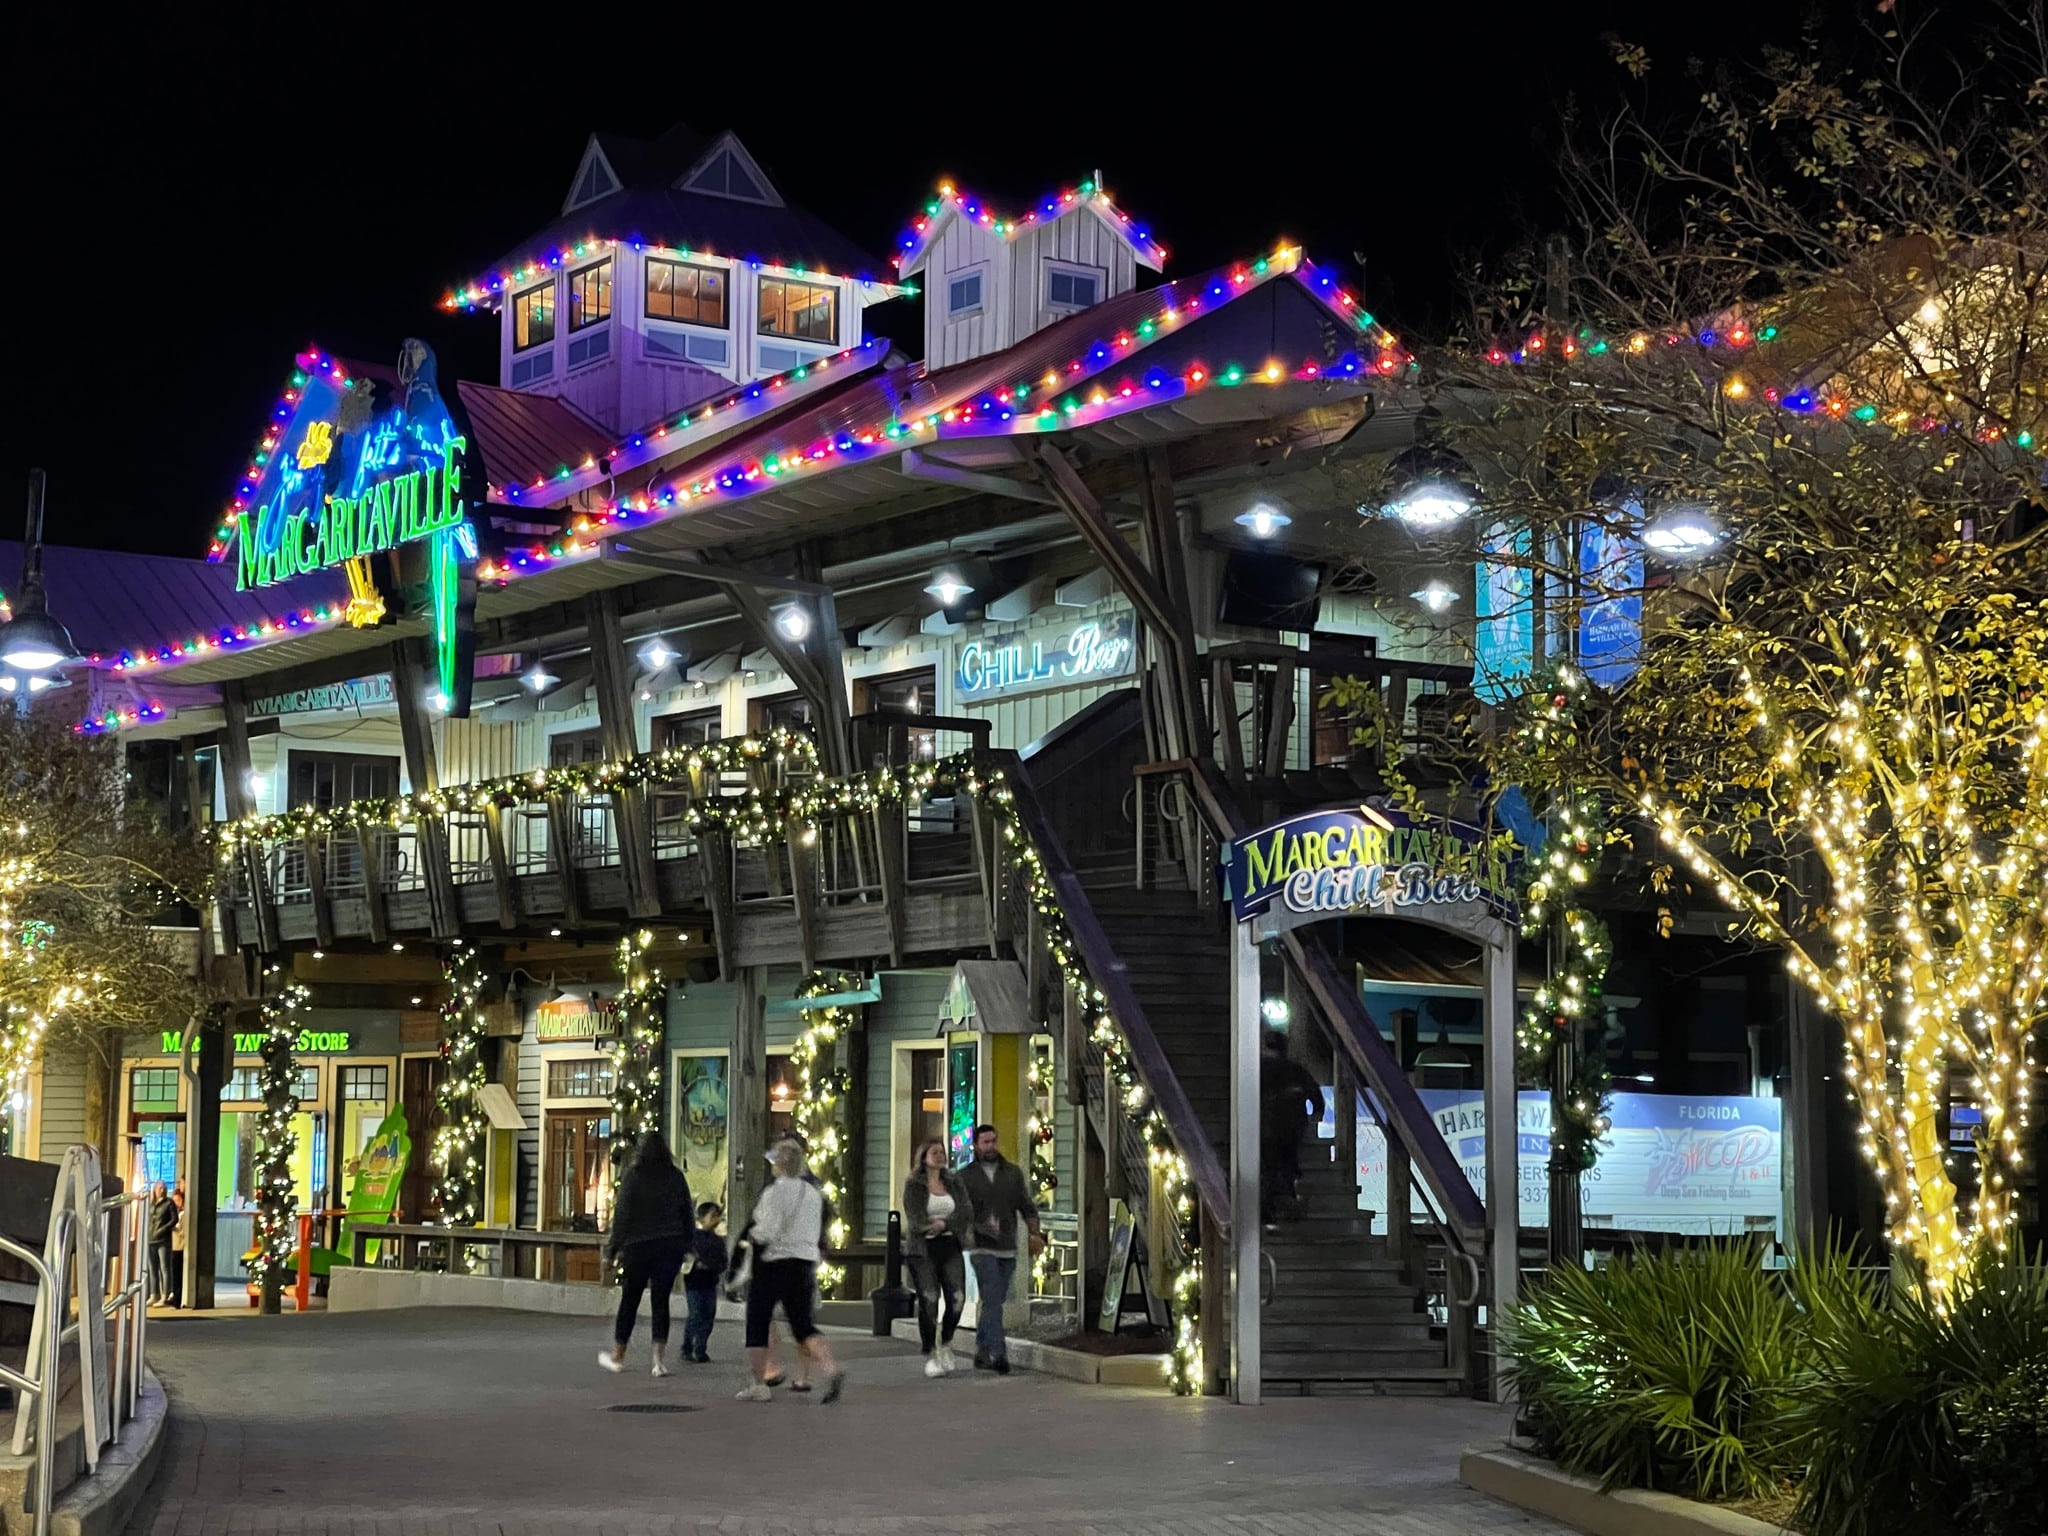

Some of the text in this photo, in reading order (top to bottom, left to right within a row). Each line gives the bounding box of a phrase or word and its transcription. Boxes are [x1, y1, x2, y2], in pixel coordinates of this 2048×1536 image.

[236, 435, 466, 592] MARGARITAVILLE
[959, 620, 1129, 693] CHILL Bar
[252, 674, 392, 715] MARGARITAVILLE
[1283, 862, 1481, 912] Chill Bar
[298, 1029, 350, 1051] STORE
[1679, 1105, 1740, 1120] FLORIDA
